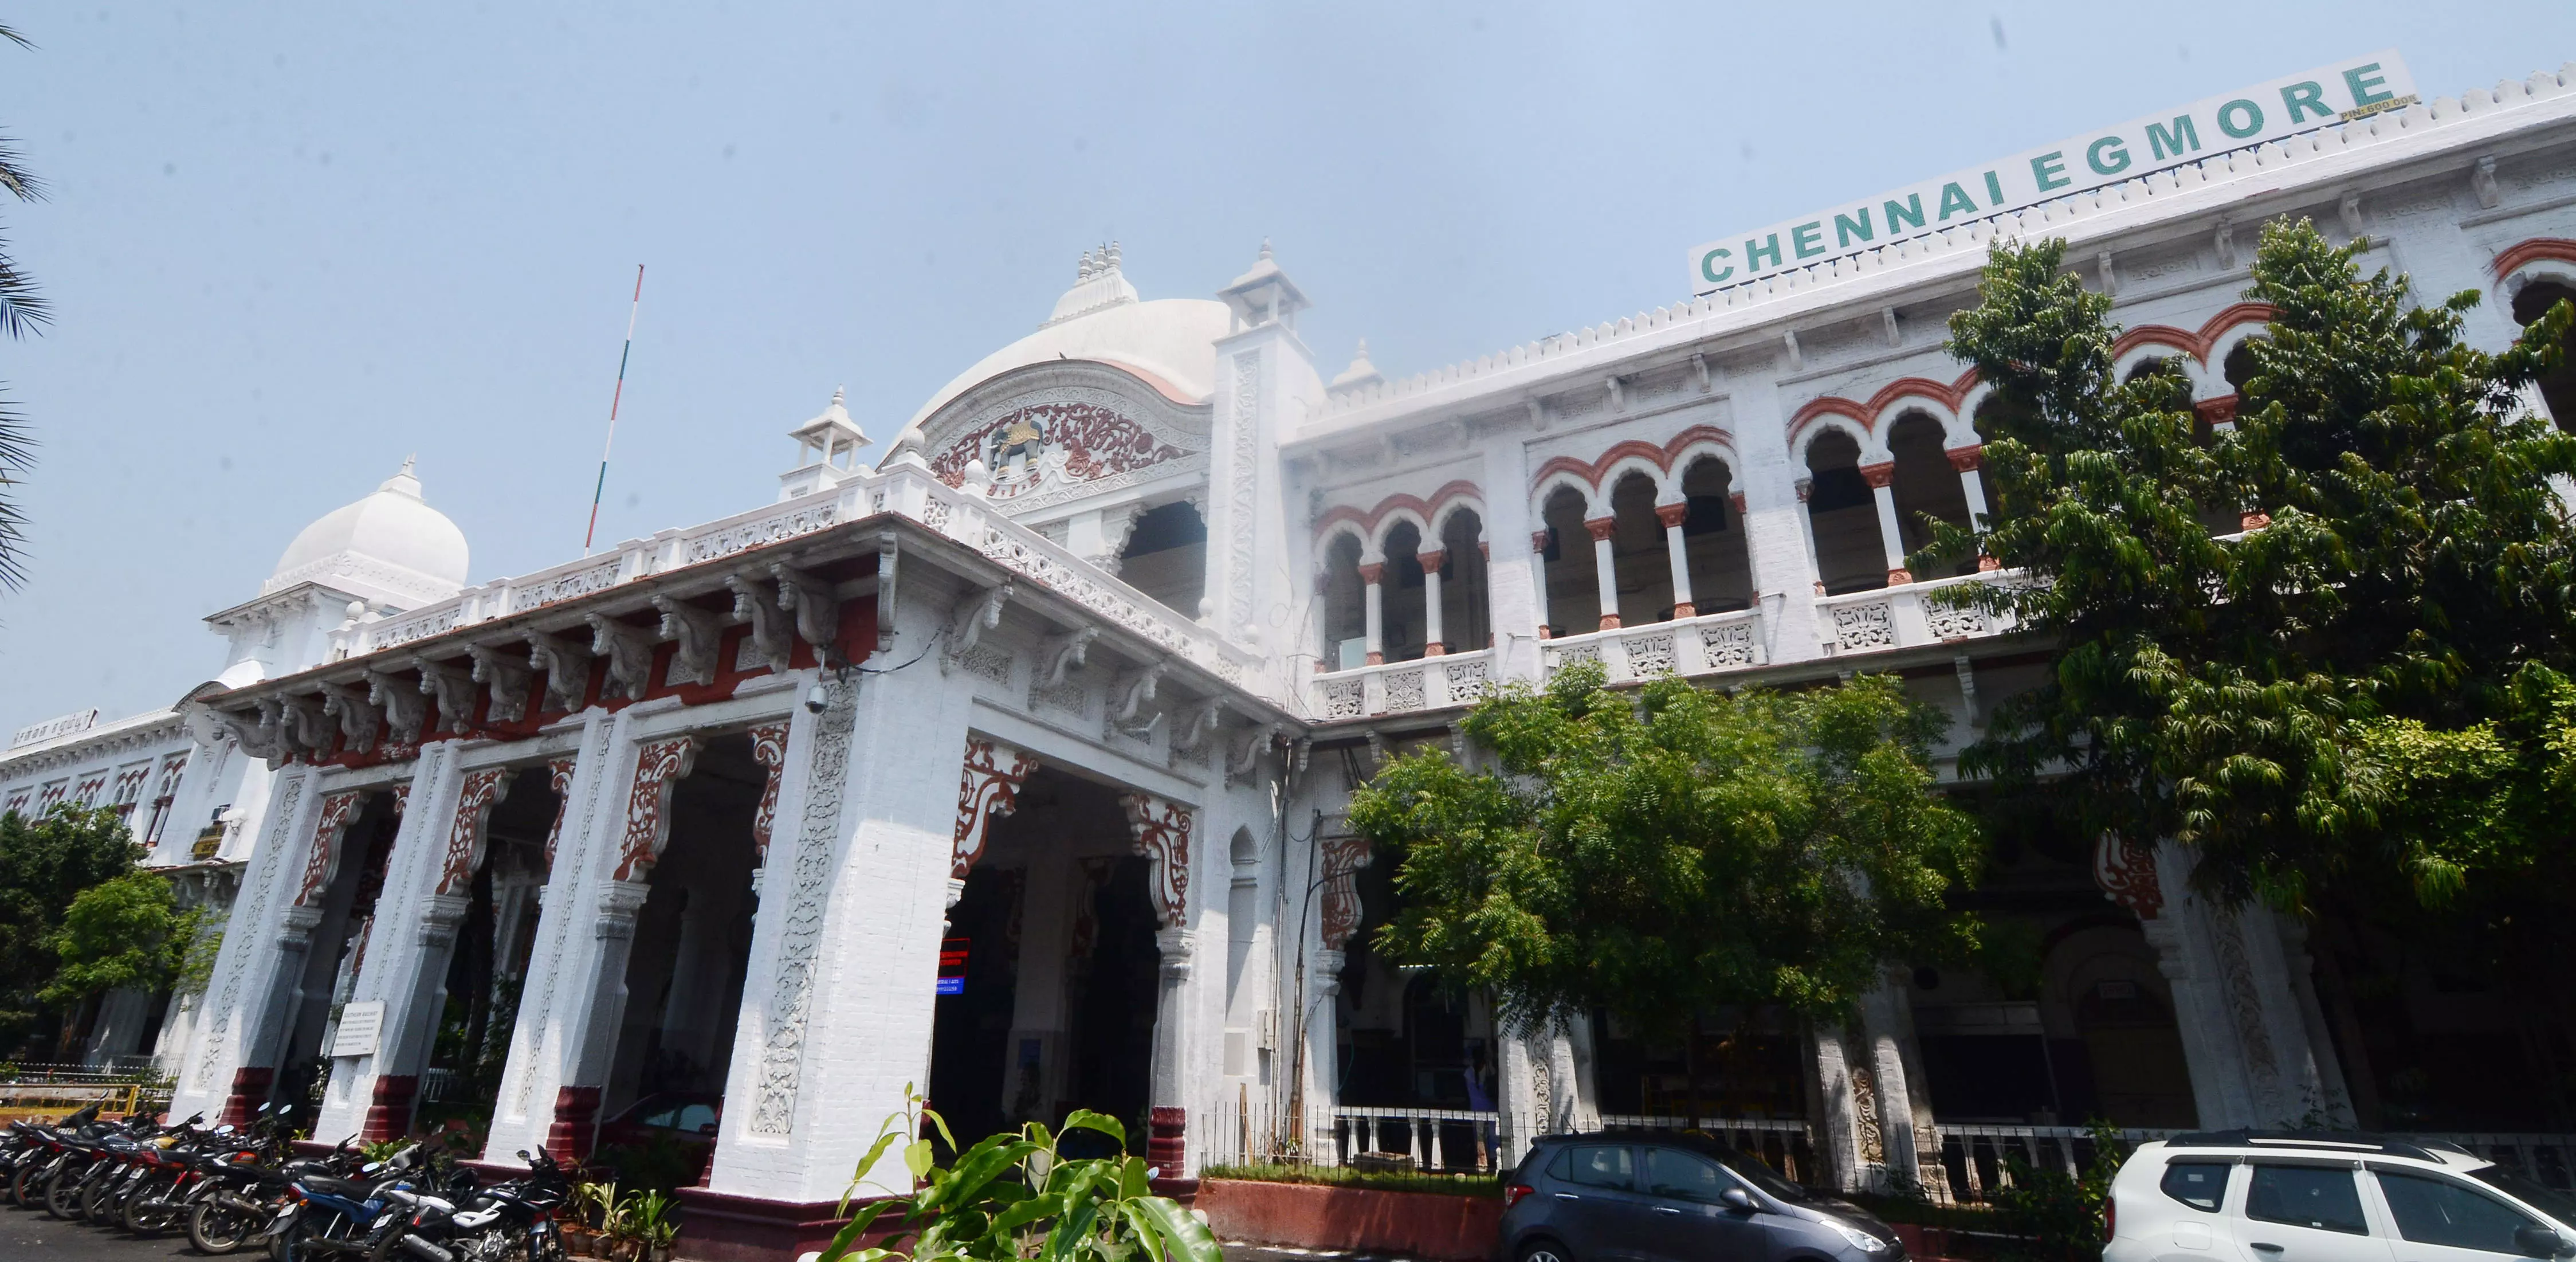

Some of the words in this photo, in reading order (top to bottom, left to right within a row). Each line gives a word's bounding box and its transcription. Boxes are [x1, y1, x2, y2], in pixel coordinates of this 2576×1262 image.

[2341, 108, 2366, 120] PIN:
[2367, 101, 2390, 113] 600
[1701, 170, 2005, 283] CHENNAI
[2030, 62, 2395, 190] EGMORE
